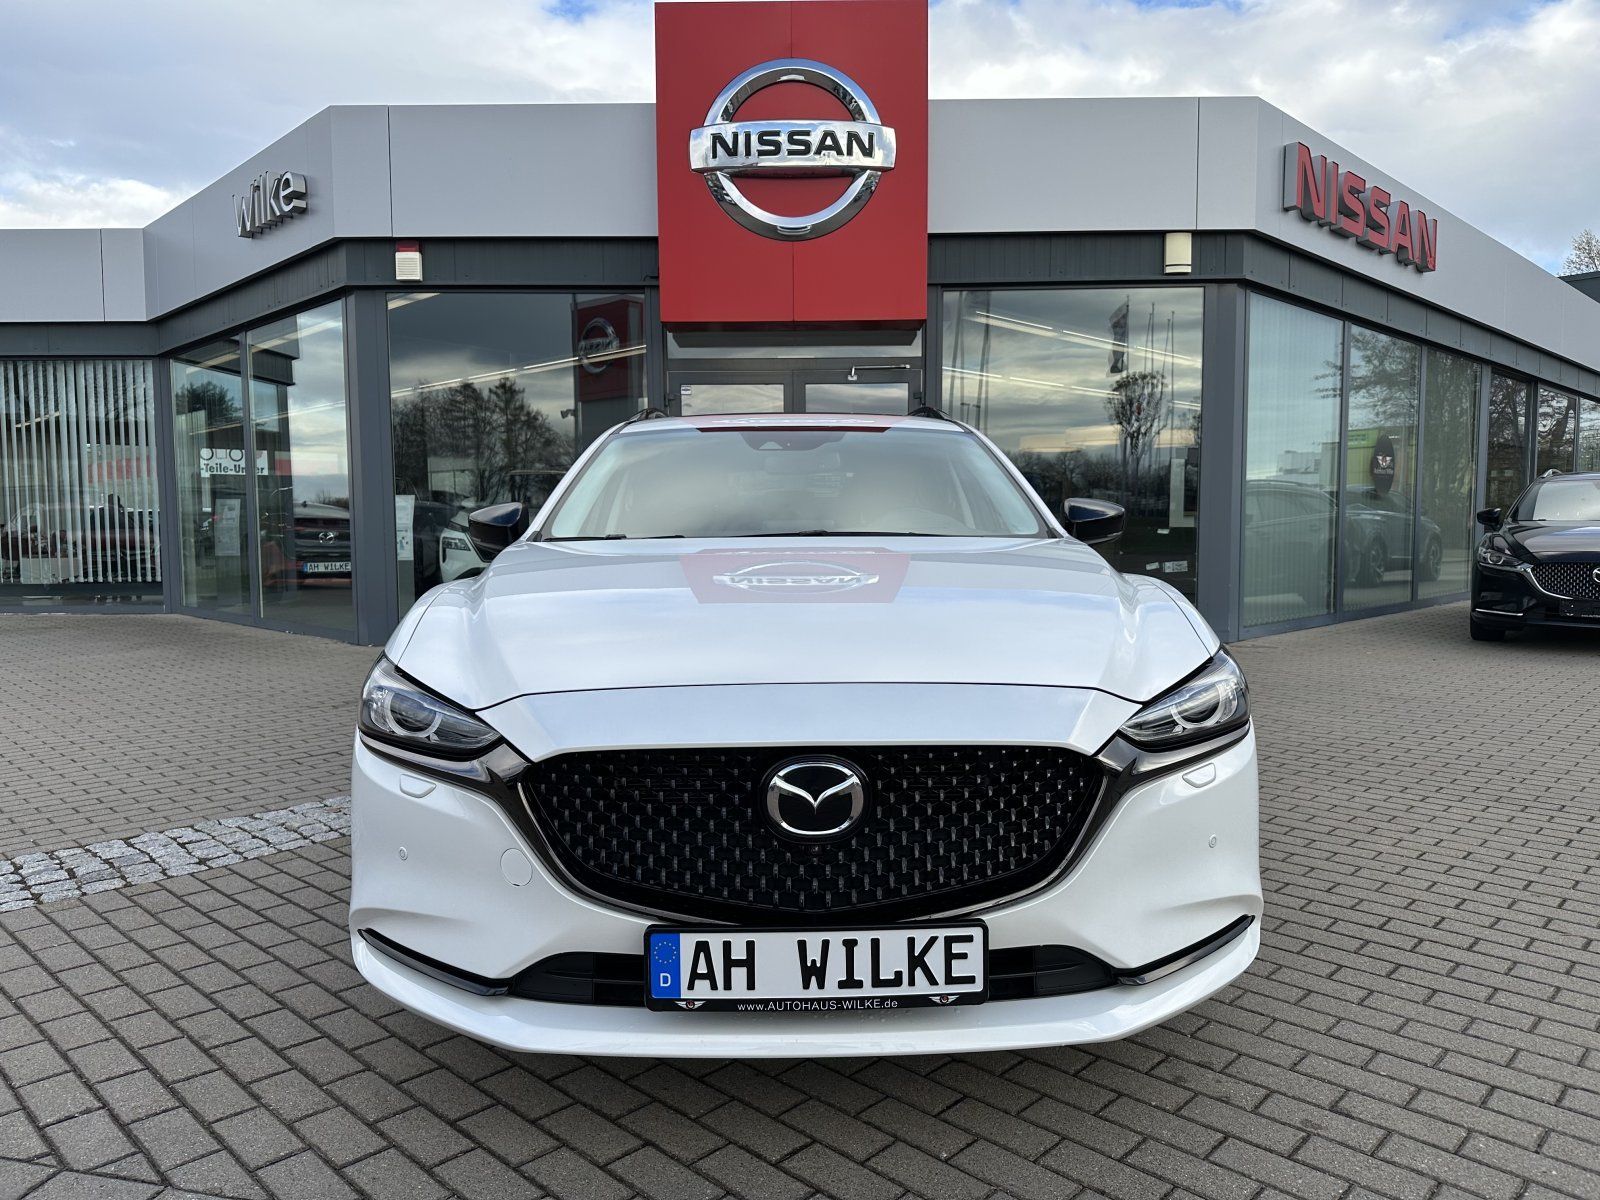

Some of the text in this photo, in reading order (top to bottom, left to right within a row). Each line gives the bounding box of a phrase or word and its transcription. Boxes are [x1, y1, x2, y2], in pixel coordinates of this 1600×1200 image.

[711, 130, 875, 159] NISSAN
[232, 171, 307, 238] Wilke
[1285, 142, 1437, 272] NISSAN
[308, 562, 350, 571] AH WILKE
[687, 934, 976, 991] AH WILKE
[660, 973, 671, 987] D
[737, 998, 898, 1011] www.AUTOHAUS-WILKE.de
